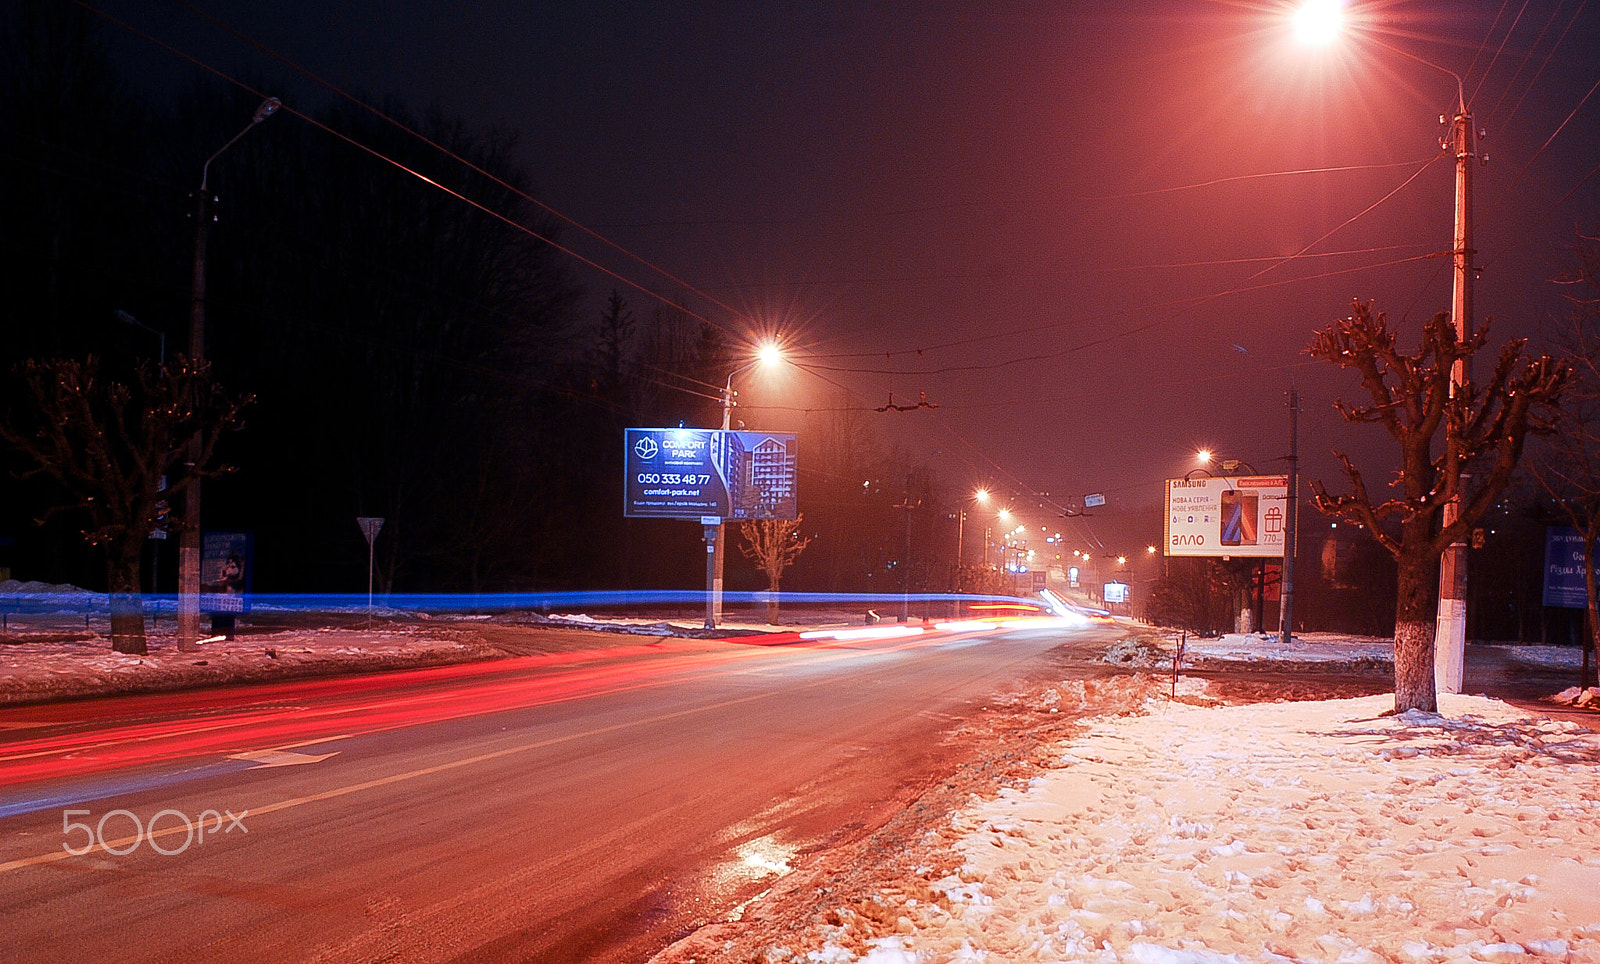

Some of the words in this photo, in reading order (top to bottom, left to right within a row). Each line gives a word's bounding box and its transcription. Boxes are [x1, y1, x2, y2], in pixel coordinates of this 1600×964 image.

[662, 440, 706, 449] COMFORT
[671, 449, 697, 458] PARK
[637, 473, 660, 484] 050
[661, 473, 681, 484] 333
[682, 474, 696, 485] 48
[697, 474, 711, 485] 77
[1173, 480, 1207, 489] SAMSUNG
[643, 488, 700, 497] comfort-park.net
[1263, 533, 1277, 543] 770
